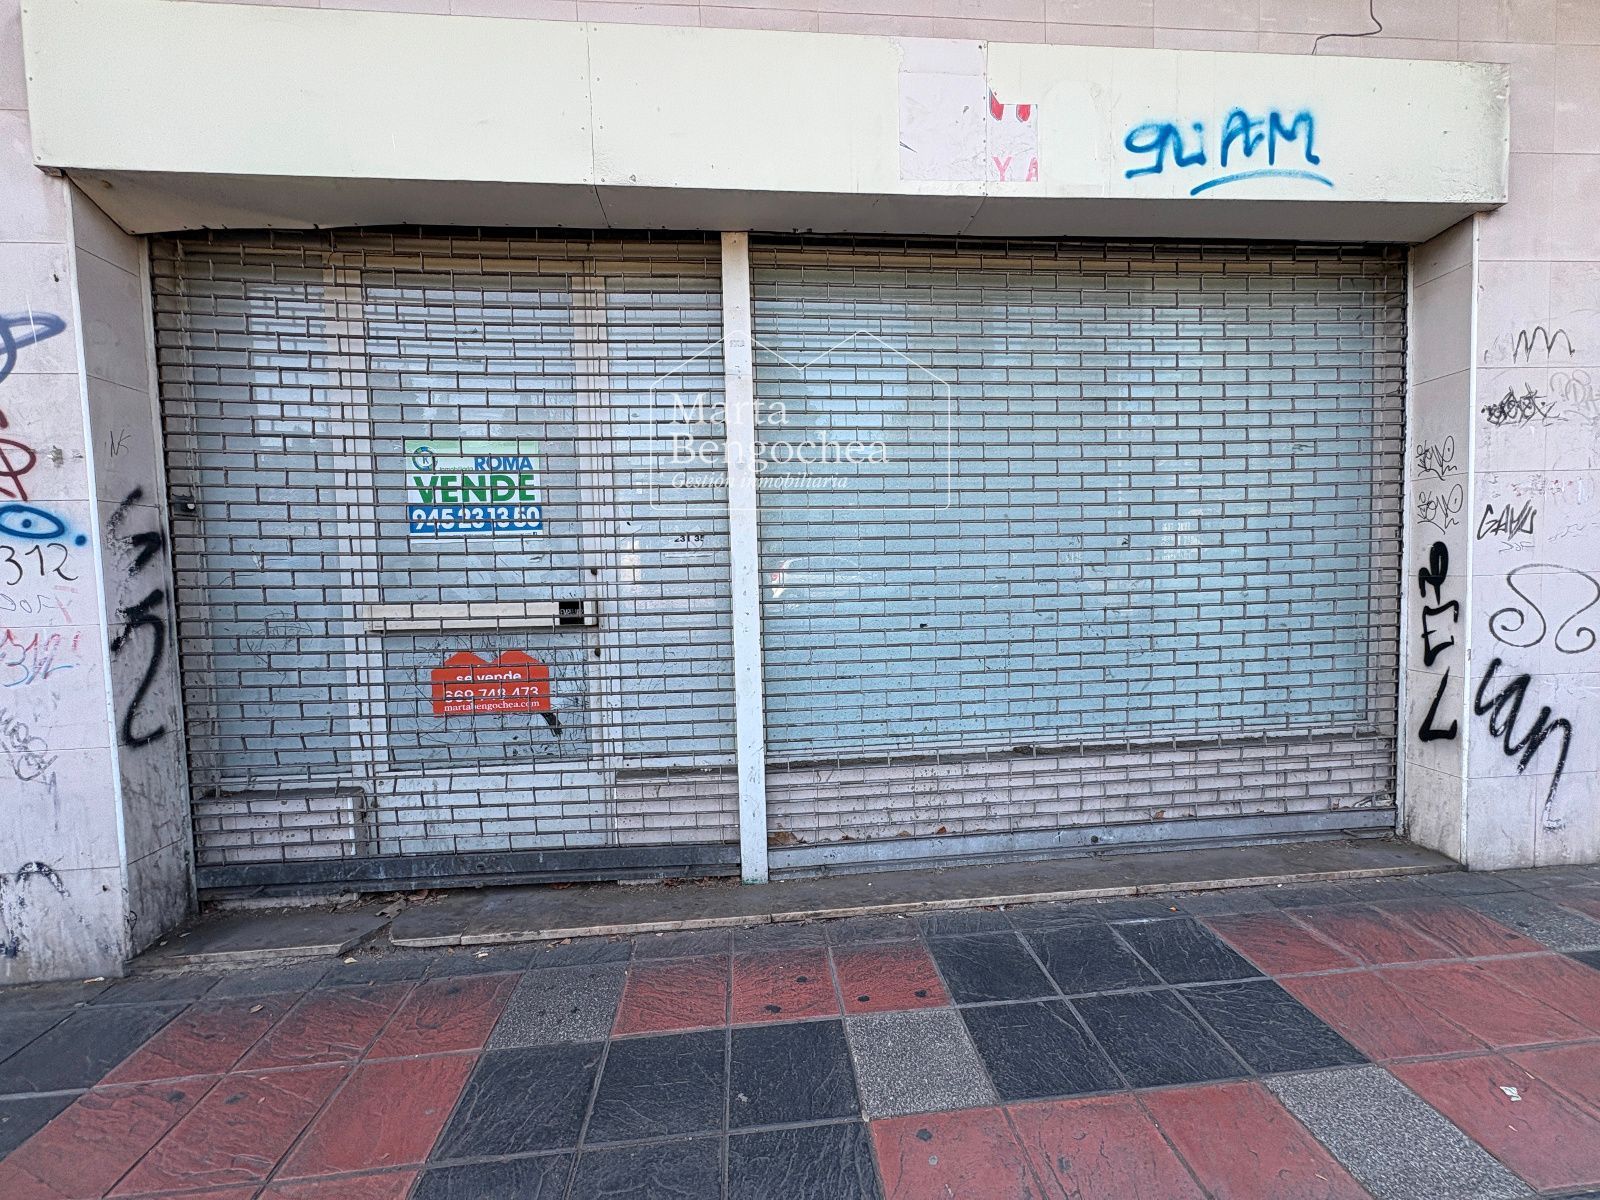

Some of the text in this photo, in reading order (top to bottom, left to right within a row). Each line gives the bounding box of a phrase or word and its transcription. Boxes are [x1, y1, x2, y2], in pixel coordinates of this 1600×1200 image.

[474, 455, 533, 471] ROMA
[413, 474, 536, 504] VENDE
[412, 508, 455, 530] 945
[476, 670, 522, 681] vende
